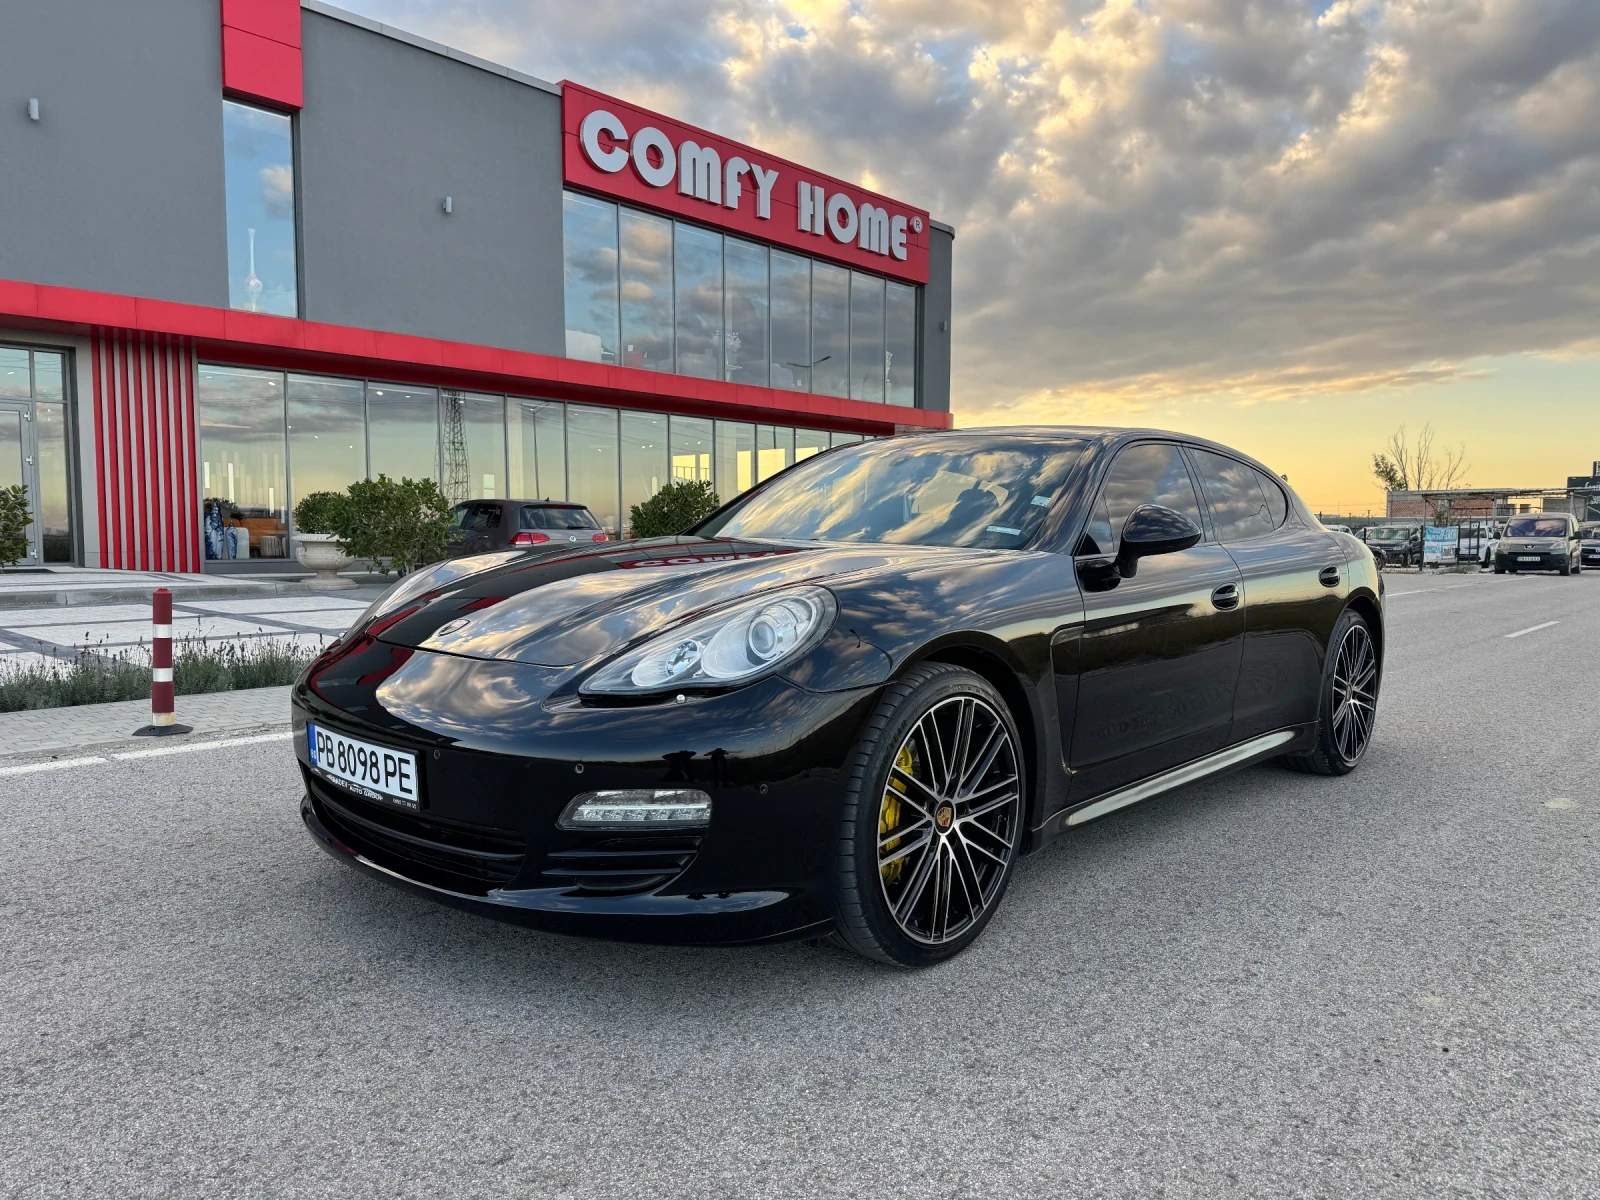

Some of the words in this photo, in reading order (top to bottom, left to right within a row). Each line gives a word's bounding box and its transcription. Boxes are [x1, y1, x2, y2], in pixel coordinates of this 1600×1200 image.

[579, 110, 779, 220] COMFY
[316, 730, 335, 768] PB
[337, 740, 381, 784] 8098
[384, 752, 412, 795] PE
